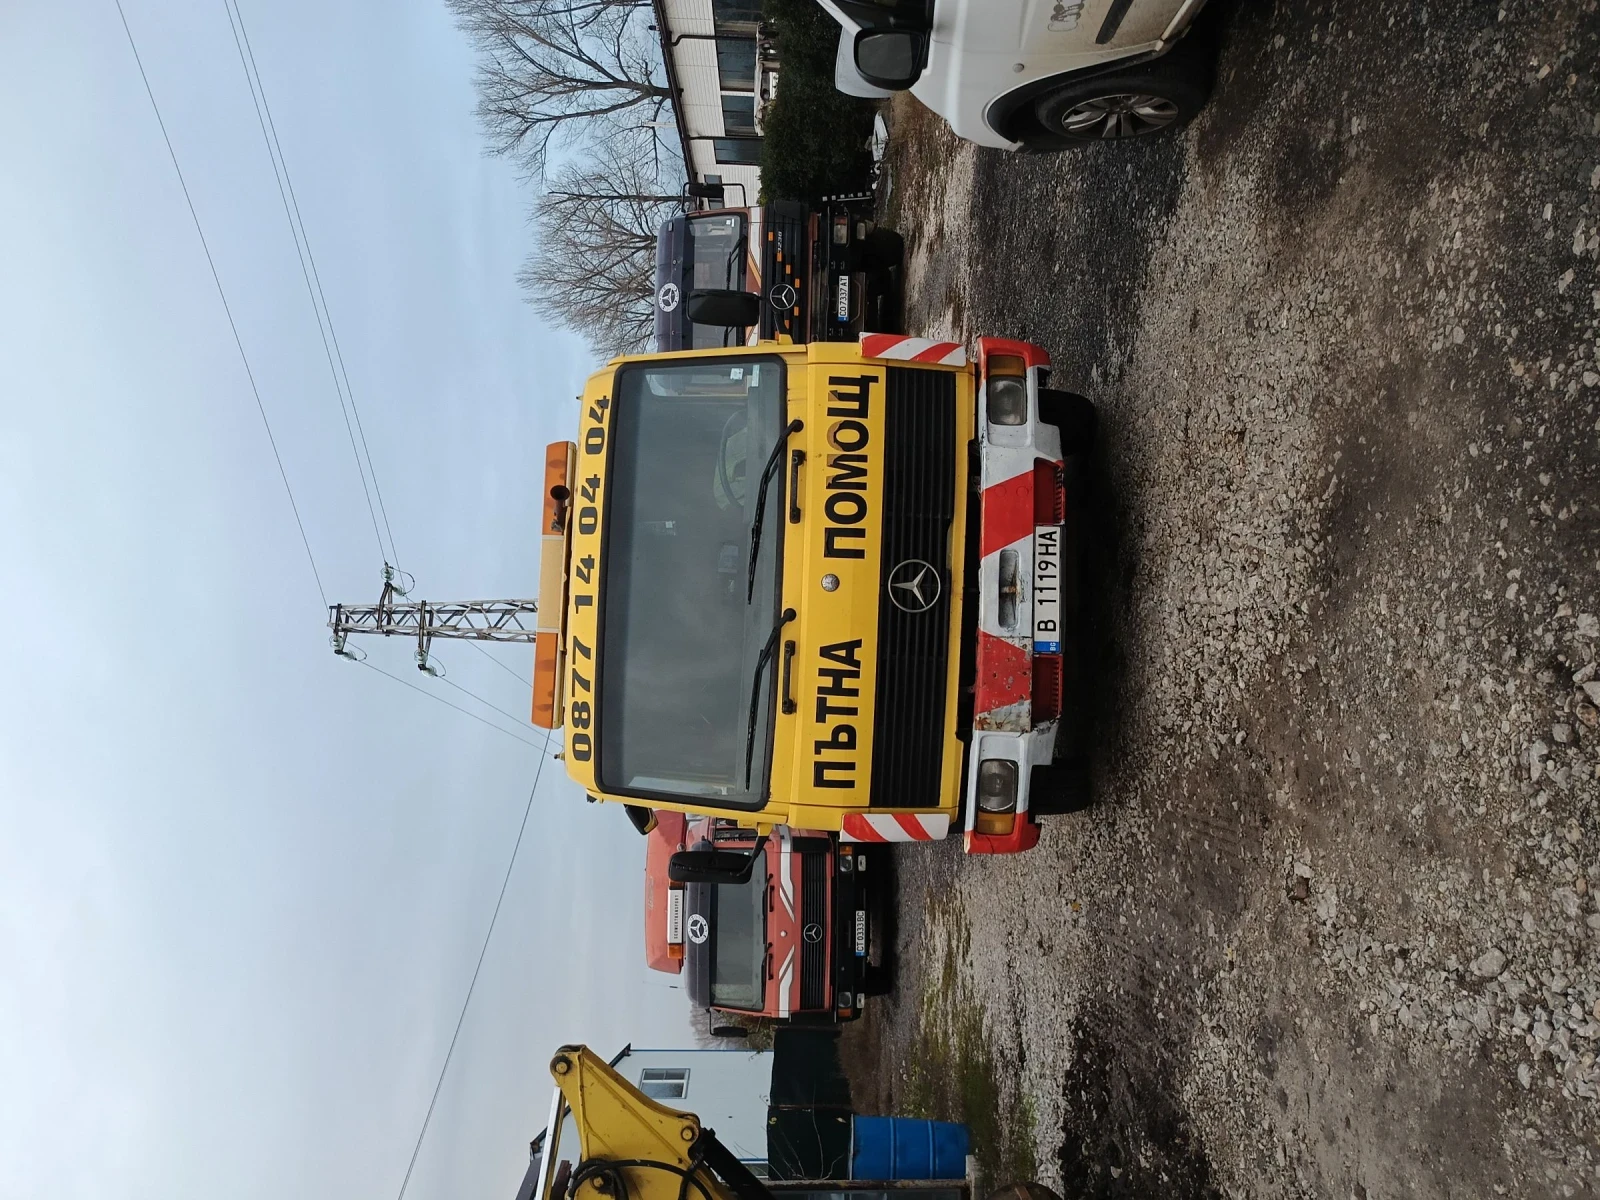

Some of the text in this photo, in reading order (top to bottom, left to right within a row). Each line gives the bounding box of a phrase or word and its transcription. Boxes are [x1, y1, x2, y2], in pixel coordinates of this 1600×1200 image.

[840, 277, 847, 286] AT
[840, 307, 846, 316] CO
[571, 396, 610, 761] 0877 14 04 04
[814, 375, 878, 788] ПЪТНА ПОМОЩ
[1037, 620, 1056, 631] B
[857, 912, 864, 922] BC
[857, 942, 863, 951] CT
